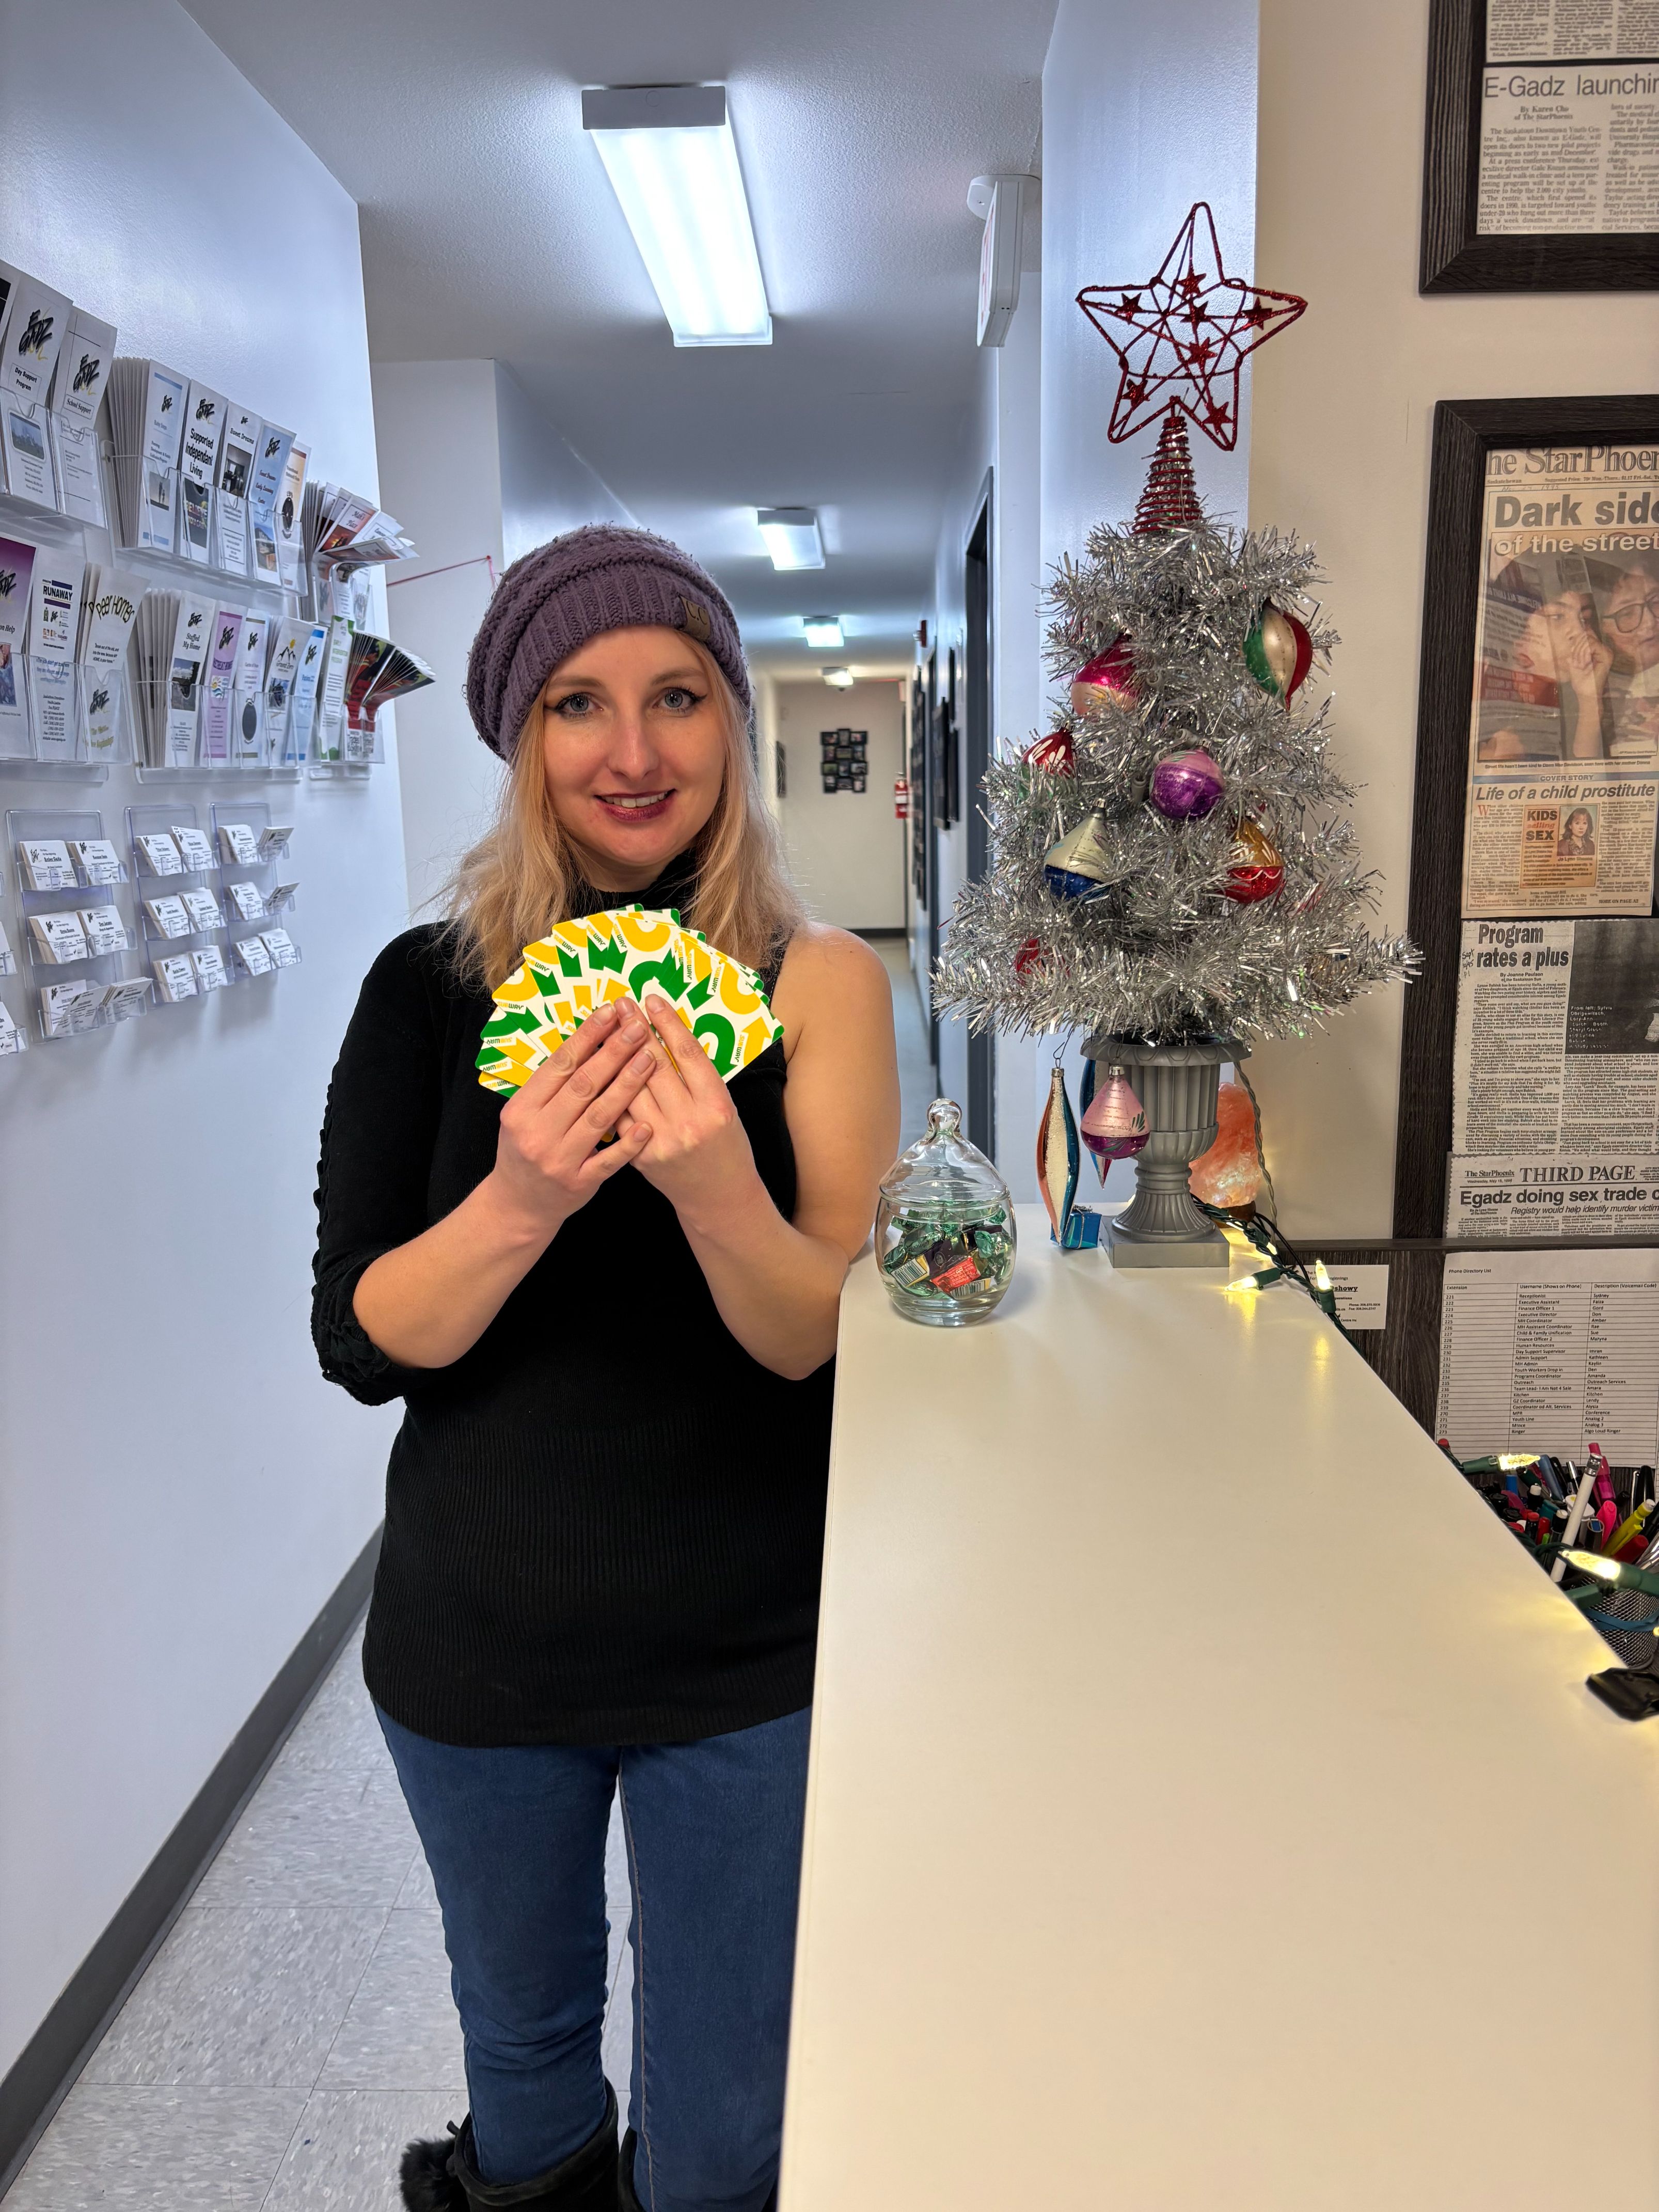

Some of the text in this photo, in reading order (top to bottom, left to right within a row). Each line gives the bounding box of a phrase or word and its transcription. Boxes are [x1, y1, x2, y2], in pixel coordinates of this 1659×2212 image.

[1484, 75, 1566, 98] E-Gadz
[14, 367, 37, 383] Day Support
[16, 378, 31, 391] Program
[67, 397, 91, 415] School Support
[190, 428, 214, 450] Supported
[189, 462, 203, 480] Living
[1495, 494, 1583, 528] Dark
[1495, 534, 1523, 556] of
[1531, 534, 1574, 554] the
[43, 585, 73, 601] RUNAWAY
[96, 594, 135, 624] Peer Homes
[5, 624, 15, 634] Help
[189, 642, 201, 651] Home
[1476, 783, 1655, 801] Life of a child prostitute
[1527, 810, 1558, 821] KIDS
[1525, 830, 1554, 841] SEX
[553, 934, 576, 953] SUBWAY
[586, 924, 606, 946] SUBWAY
[614, 923, 627, 949] SUBWAY
[1478, 924, 1544, 949] Program
[526, 956, 550, 972] SUBWAY
[1476, 947, 1518, 968] rates
[1521, 951, 1531, 967] a
[1535, 946, 1569, 971] plus
[711, 966, 721, 993] SUBWAY
[497, 1001, 524, 1010] SUBWAY
[734, 1034, 745, 1063] SUBWAY
[1519, 1166, 1584, 1182] THIRD
[1587, 1165, 1636, 1181] PAGE
[1460, 1190, 1512, 1208] Egadz
[1515, 1188, 1564, 1206] doing
[1568, 1190, 1599, 1202] sex
[1603, 1187, 1647, 1201] trade
[1511, 1206, 1541, 1216] Registry
[1542, 1206, 1565, 1214] would
[1565, 1205, 1581, 1215] help
[1582, 1204, 1609, 1214] identify
[1610, 1204, 1637, 1212] murder
